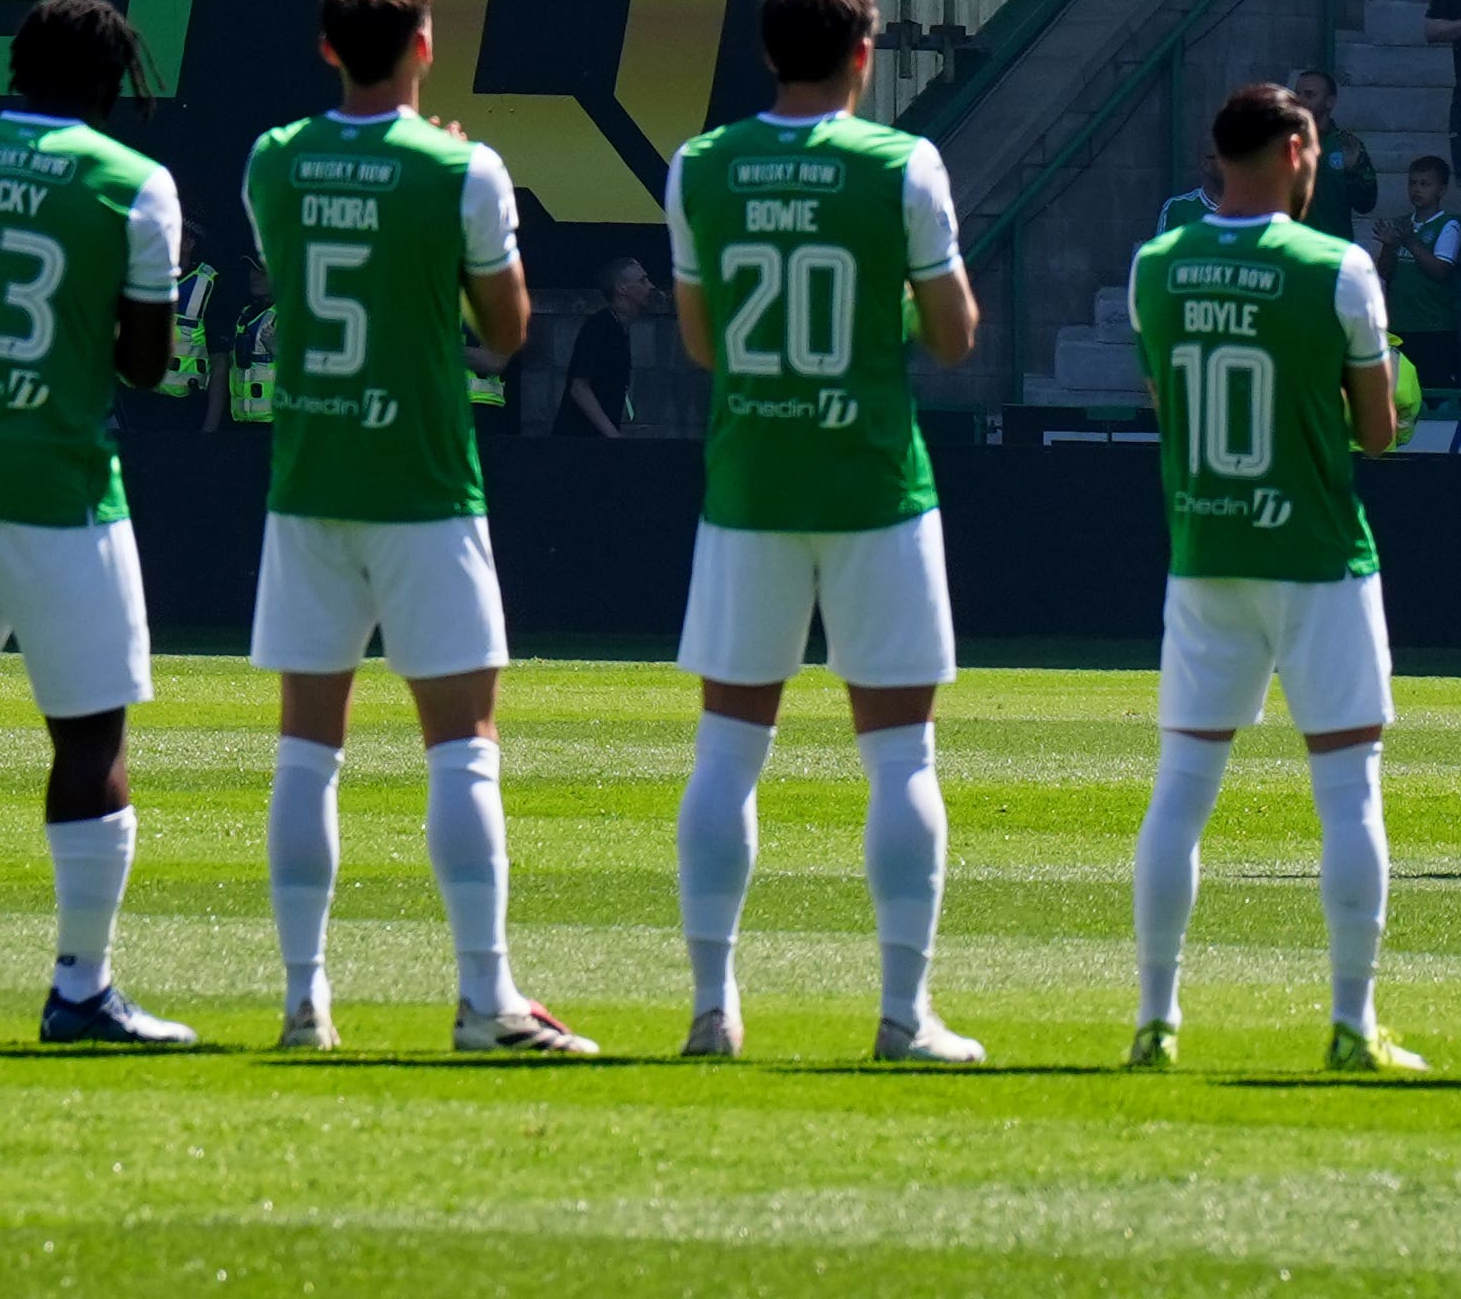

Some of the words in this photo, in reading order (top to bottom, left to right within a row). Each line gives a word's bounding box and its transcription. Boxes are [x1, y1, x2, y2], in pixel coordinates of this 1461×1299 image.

[745, 199, 820, 234] BOWIE
[302, 241, 373, 377] 5
[721, 242, 858, 377] 20
[1184, 299, 1260, 337] BOYLE
[1171, 342, 1275, 479] 10
